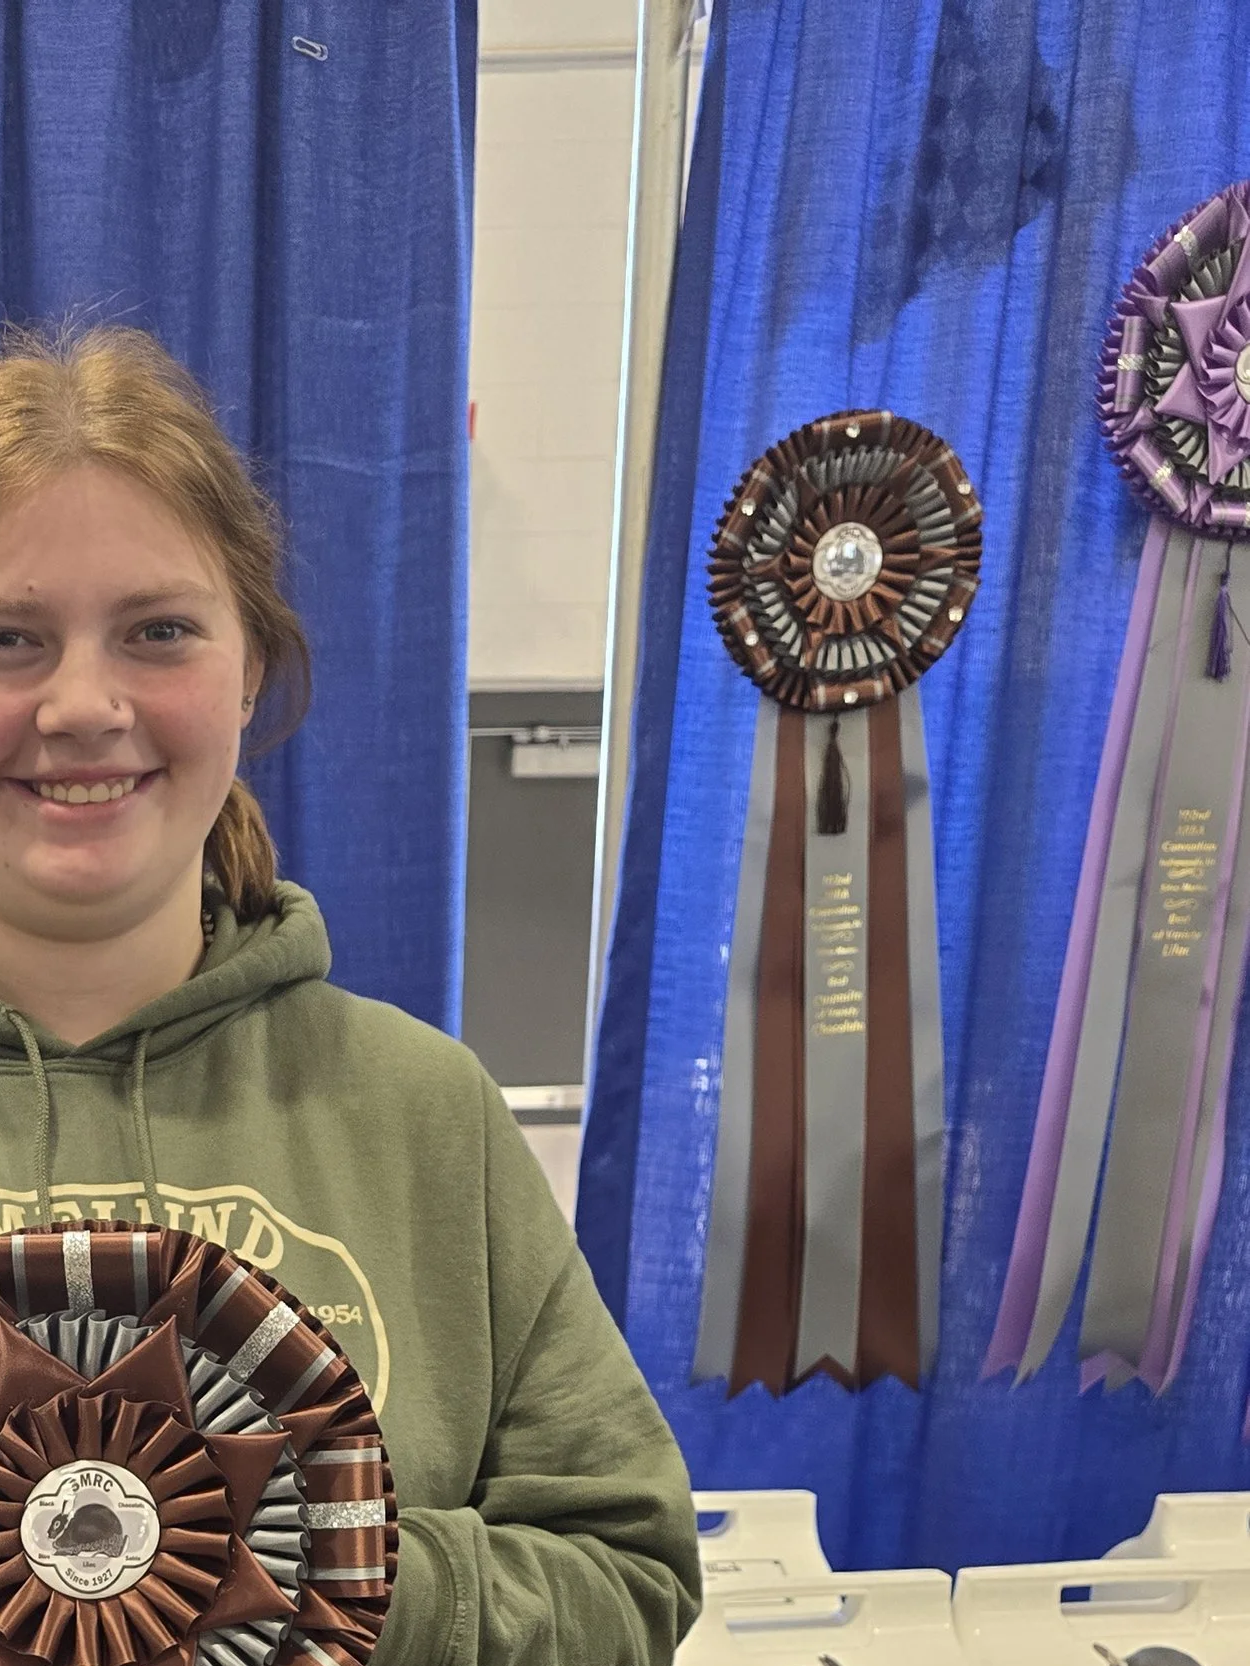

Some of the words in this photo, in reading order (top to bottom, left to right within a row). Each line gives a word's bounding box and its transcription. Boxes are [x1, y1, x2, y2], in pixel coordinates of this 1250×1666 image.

[70, 1473, 114, 1493] SMRC
[65, 1568, 89, 1587] Since
[92, 1569, 113, 1587] 1927
